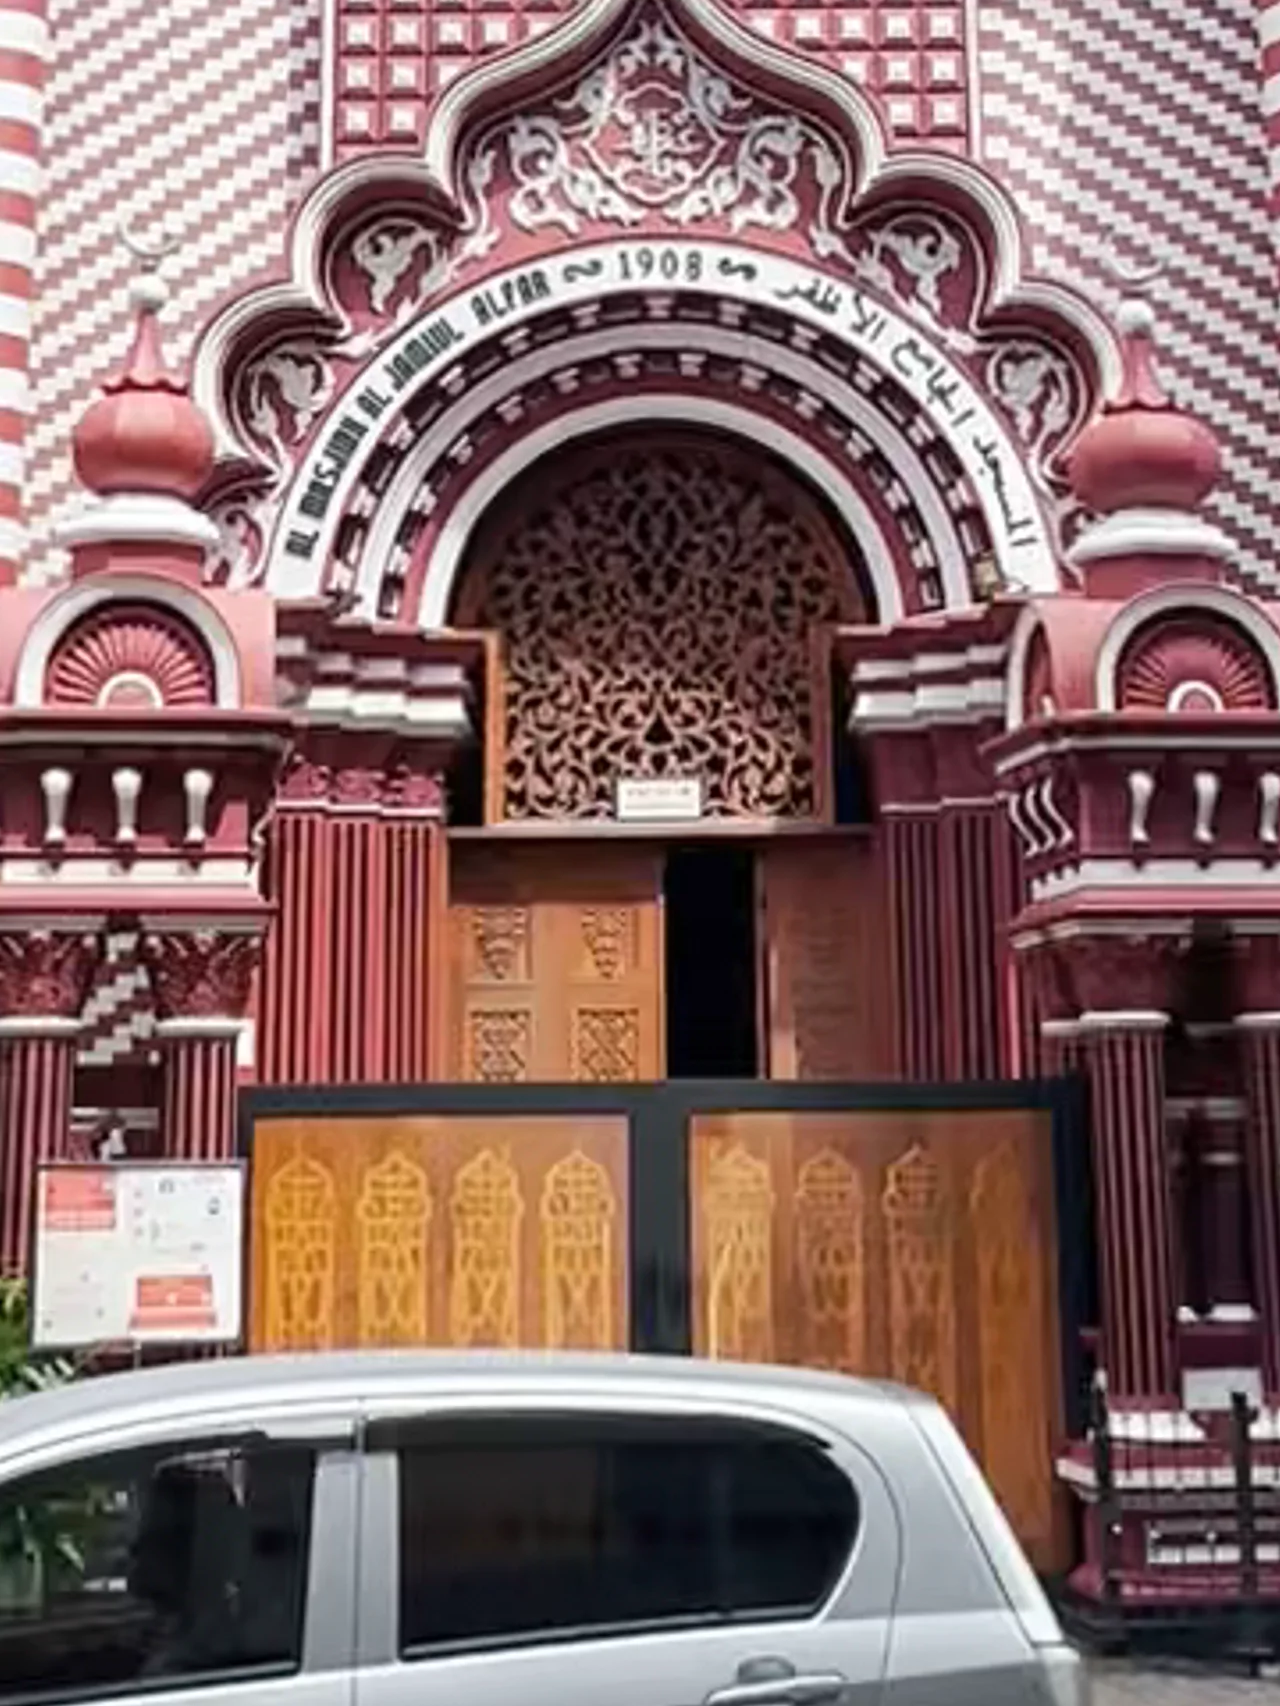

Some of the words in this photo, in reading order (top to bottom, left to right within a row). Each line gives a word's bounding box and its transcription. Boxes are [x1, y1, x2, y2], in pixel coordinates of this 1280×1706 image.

[617, 247, 704, 282] 1908
[284, 530, 320, 560] AL
[355, 385, 394, 421] AL
[383, 317, 465, 393] JAMIUL
[471, 269, 552, 326] ALFAR
